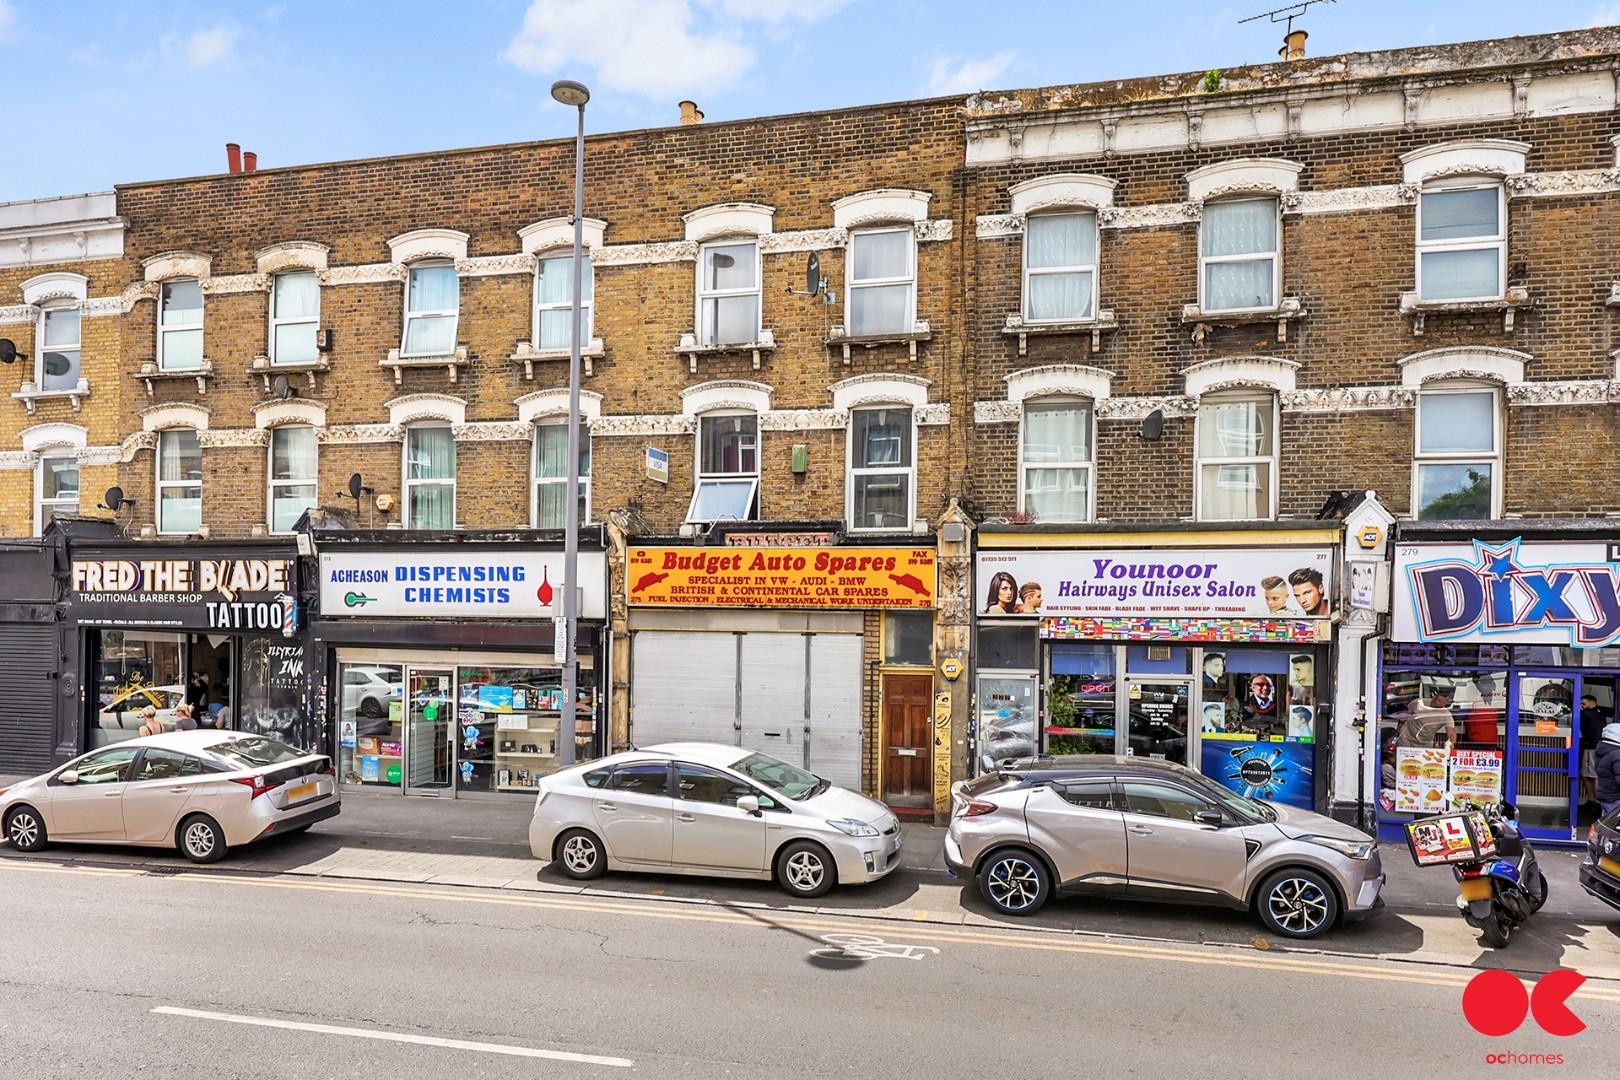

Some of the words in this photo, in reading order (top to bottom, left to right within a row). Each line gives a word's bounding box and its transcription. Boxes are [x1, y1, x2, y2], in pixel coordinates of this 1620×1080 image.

[662, 552, 742, 574] Budget
[748, 552, 806, 571] Auto
[814, 552, 896, 575] Spares
[1093, 559, 1217, 579] Younoor
[72, 560, 138, 592] FRED
[141, 560, 190, 592] THE
[199, 559, 287, 596] BLADE
[330, 569, 388, 583] ACHEASON
[395, 566, 526, 582] DISPENSING
[688, 576, 752, 585] SPECIALIST
[755, 577, 766, 585] IN
[771, 577, 788, 585] VW
[800, 577, 826, 585] AUDI
[838, 577, 866, 585] BMW
[79, 593, 139, 602] TRADITIONAL
[140, 594, 175, 603] BARBER
[176, 594, 203, 604] SHOP
[404, 587, 510, 603] CHEMISTS
[671, 586, 715, 594] BRITISH
[720, 587, 728, 595] &
[733, 587, 810, 596] CONTINENTAL
[815, 587, 839, 595] CAR
[844, 588, 888, 596] SPARES
[1058, 580, 1137, 601] Hairways
[1143, 581, 1200, 597] Unisex
[1206, 581, 1256, 597] Salon
[206, 602, 282, 629] TATTOO
[278, 658, 304, 678] INK
[1453, 757, 1458, 766] 2
[1459, 758, 1475, 766] FOR
[1476, 758, 1500, 767] £3.99
[1446, 822, 1460, 835] L
